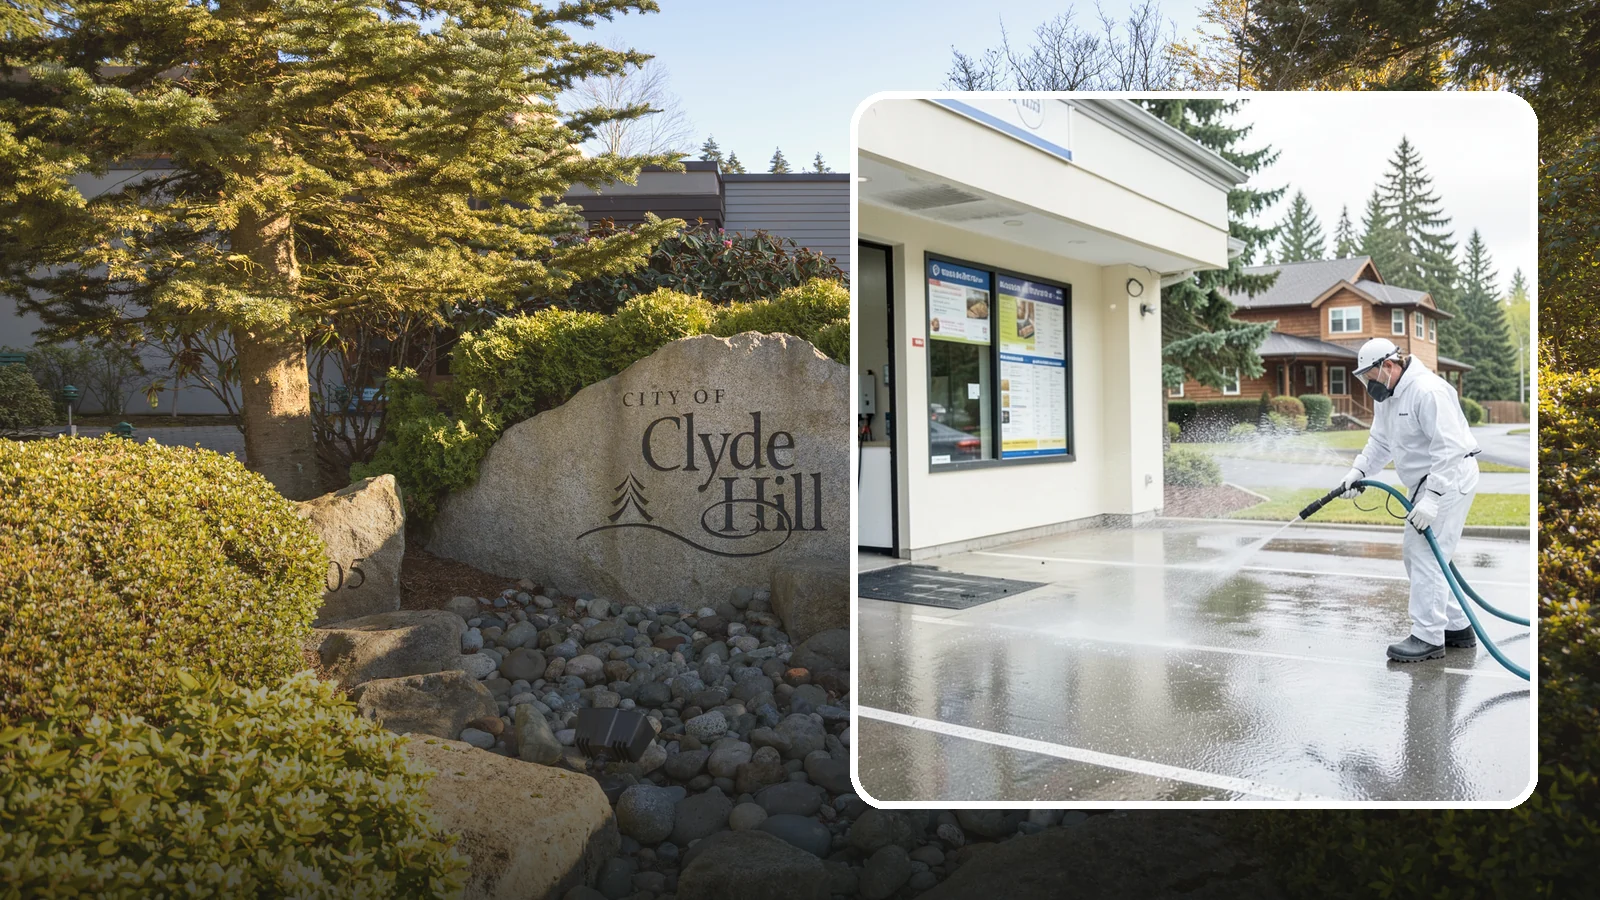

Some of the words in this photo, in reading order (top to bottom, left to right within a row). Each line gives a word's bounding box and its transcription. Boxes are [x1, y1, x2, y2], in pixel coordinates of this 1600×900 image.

[622, 390, 681, 407] CITY
[693, 388, 726, 405] OF
[641, 410, 795, 493] Clyde
[718, 472, 828, 532] Hill
